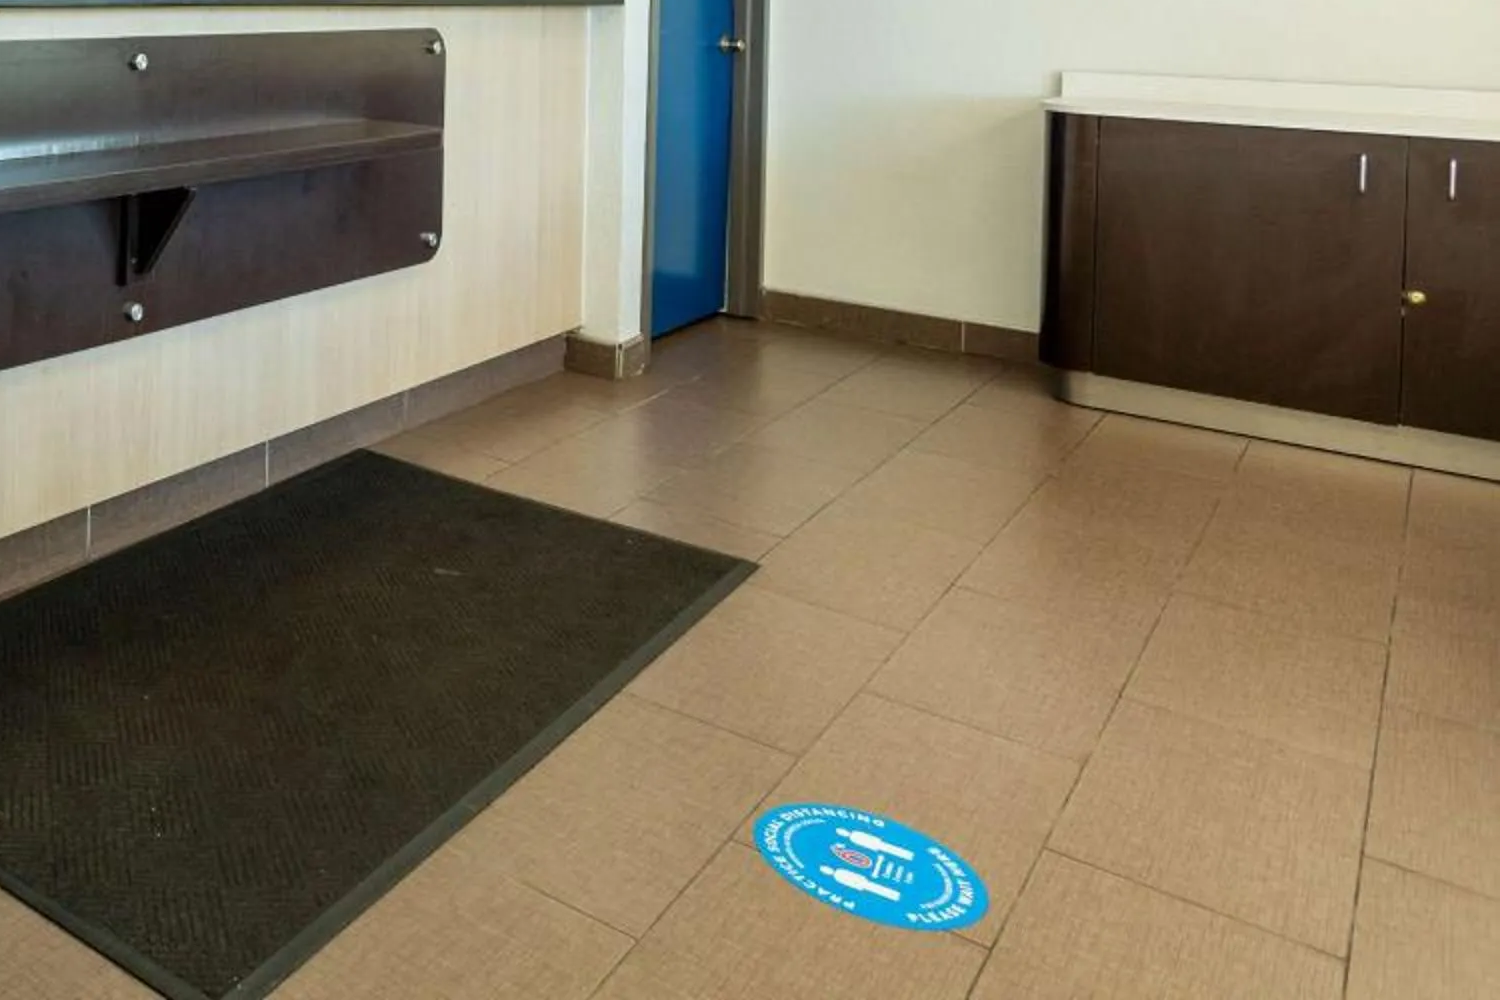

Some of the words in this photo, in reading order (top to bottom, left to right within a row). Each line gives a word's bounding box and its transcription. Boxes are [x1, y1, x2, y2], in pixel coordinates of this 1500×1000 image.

[780, 807, 886, 828] DISTANCING
[763, 819, 784, 854] SOCIAL
[773, 855, 856, 911] PRACTICE
[904, 902, 967, 924] PLEASE
